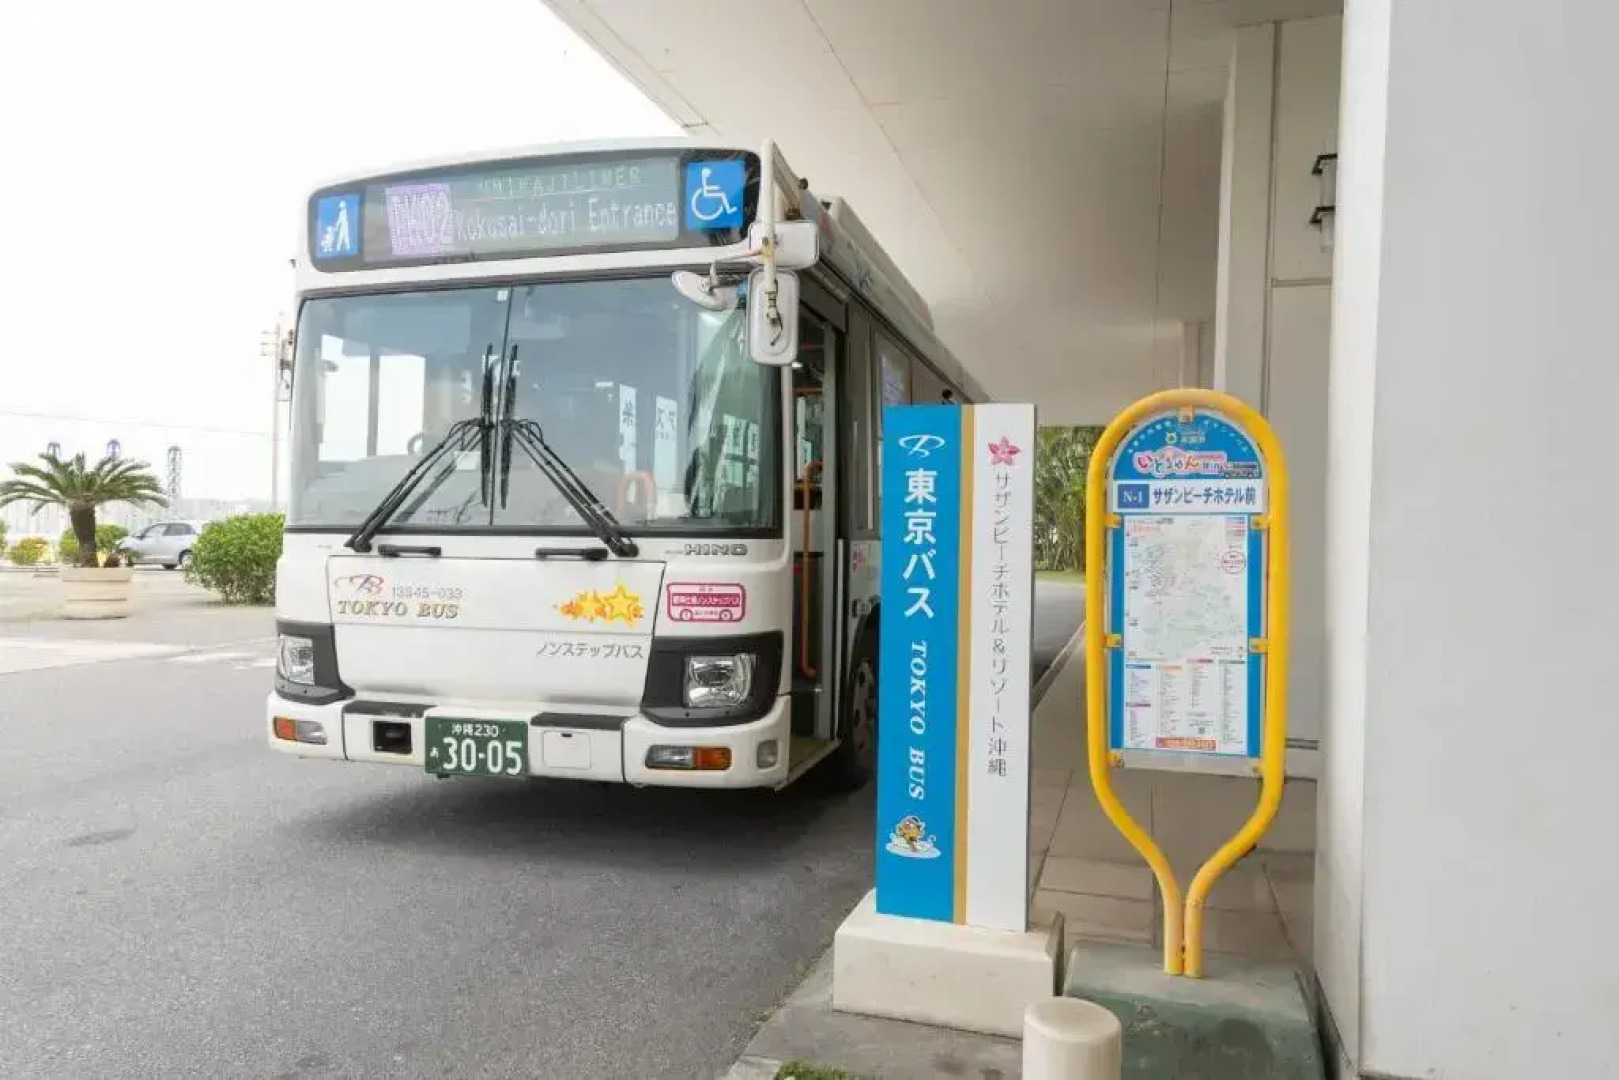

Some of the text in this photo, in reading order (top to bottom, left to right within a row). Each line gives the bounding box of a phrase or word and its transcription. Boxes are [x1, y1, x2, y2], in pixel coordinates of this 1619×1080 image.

[588, 197, 677, 232] Entrance
[1153, 485, 1257, 506] サザンビーチホテル前
[684, 543, 747, 556] HINO
[902, 467, 937, 619] 東京バス
[338, 600, 459, 619] TOKYO BUS
[535, 641, 644, 659] ノンステップバス
[908, 639, 928, 801] TOKYO BUS
[443, 737, 523, 775] 30-05
